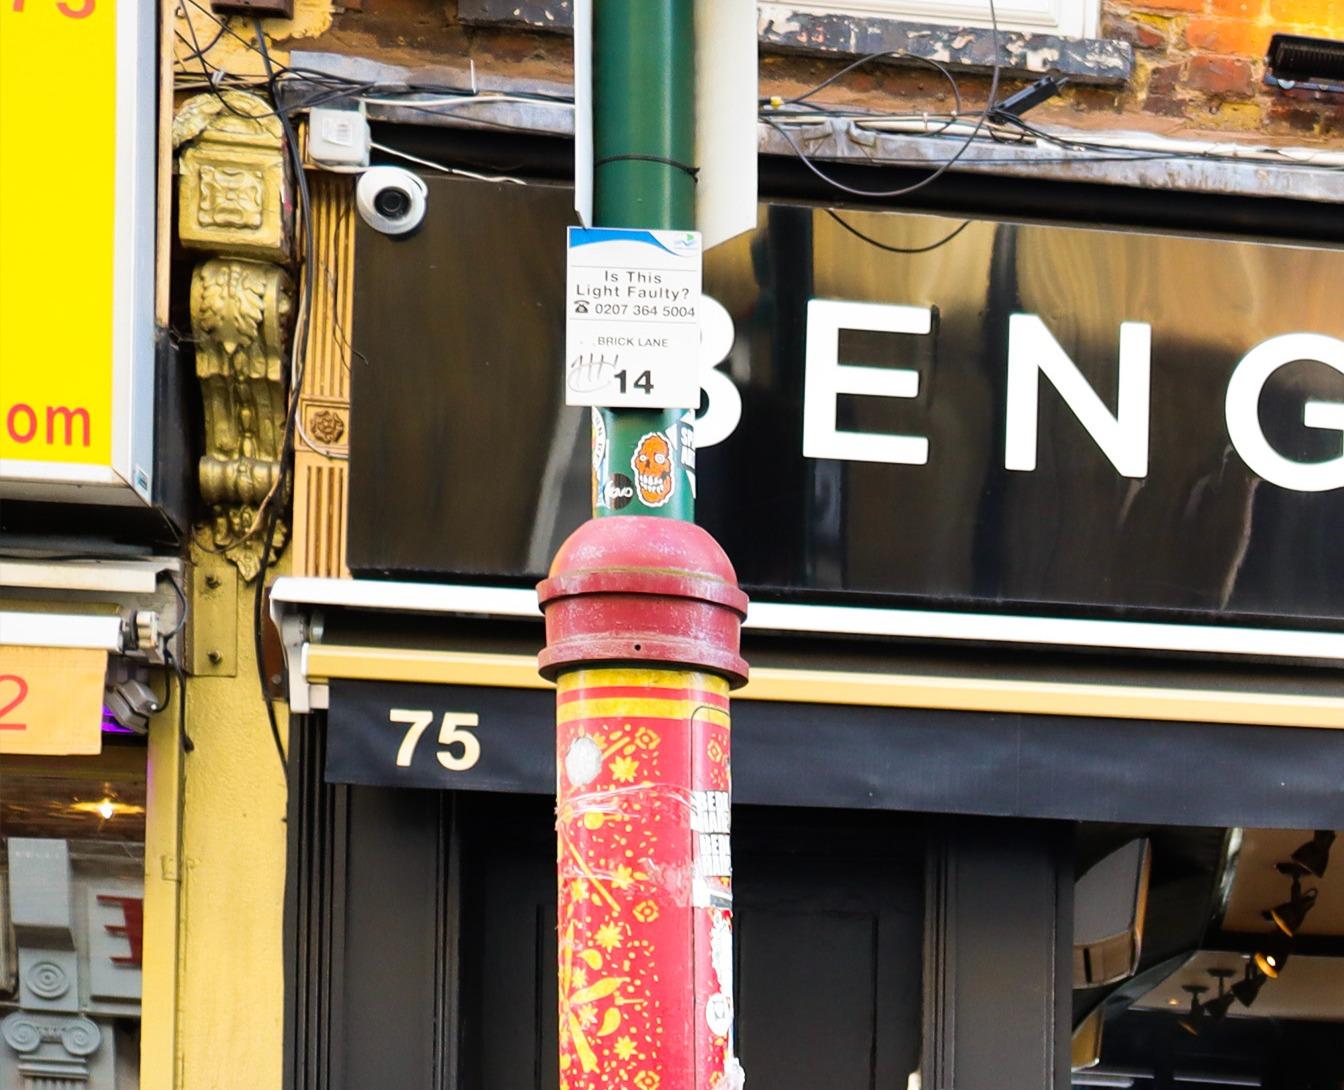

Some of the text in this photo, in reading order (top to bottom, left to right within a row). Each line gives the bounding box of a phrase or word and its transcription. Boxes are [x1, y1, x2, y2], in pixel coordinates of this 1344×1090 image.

[604, 270, 662, 284] Is This
[576, 284, 690, 301] Light Faulty?
[595, 303, 695, 317] 0207 364 5004
[597, 336, 669, 347] BRICK LANE
[613, 369, 655, 394] 14
[389, 708, 481, 771] 75
